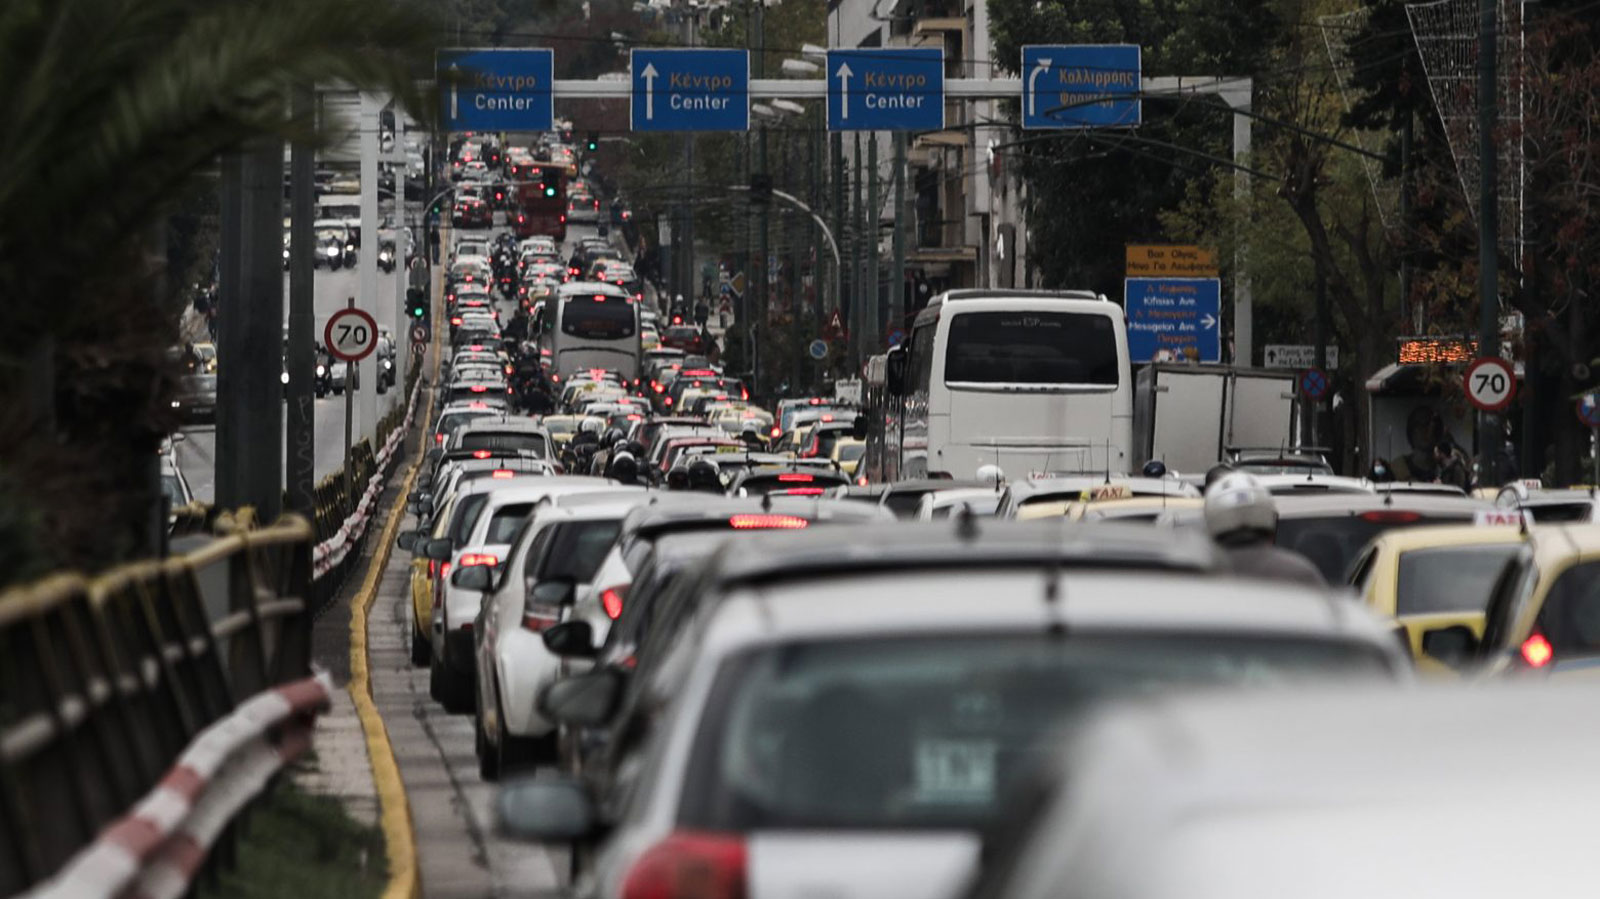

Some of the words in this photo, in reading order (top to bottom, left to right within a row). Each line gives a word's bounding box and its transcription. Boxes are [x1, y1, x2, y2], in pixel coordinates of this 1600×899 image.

[670, 72, 732, 91] Κέντρο
[865, 72, 926, 90] Κέντρο
[475, 94, 533, 110] Center
[670, 94, 730, 110] Center
[865, 93, 924, 109] Center
[338, 324, 367, 345] 70
[1475, 373, 1505, 394] 70
[1095, 487, 1124, 500] TAXI
